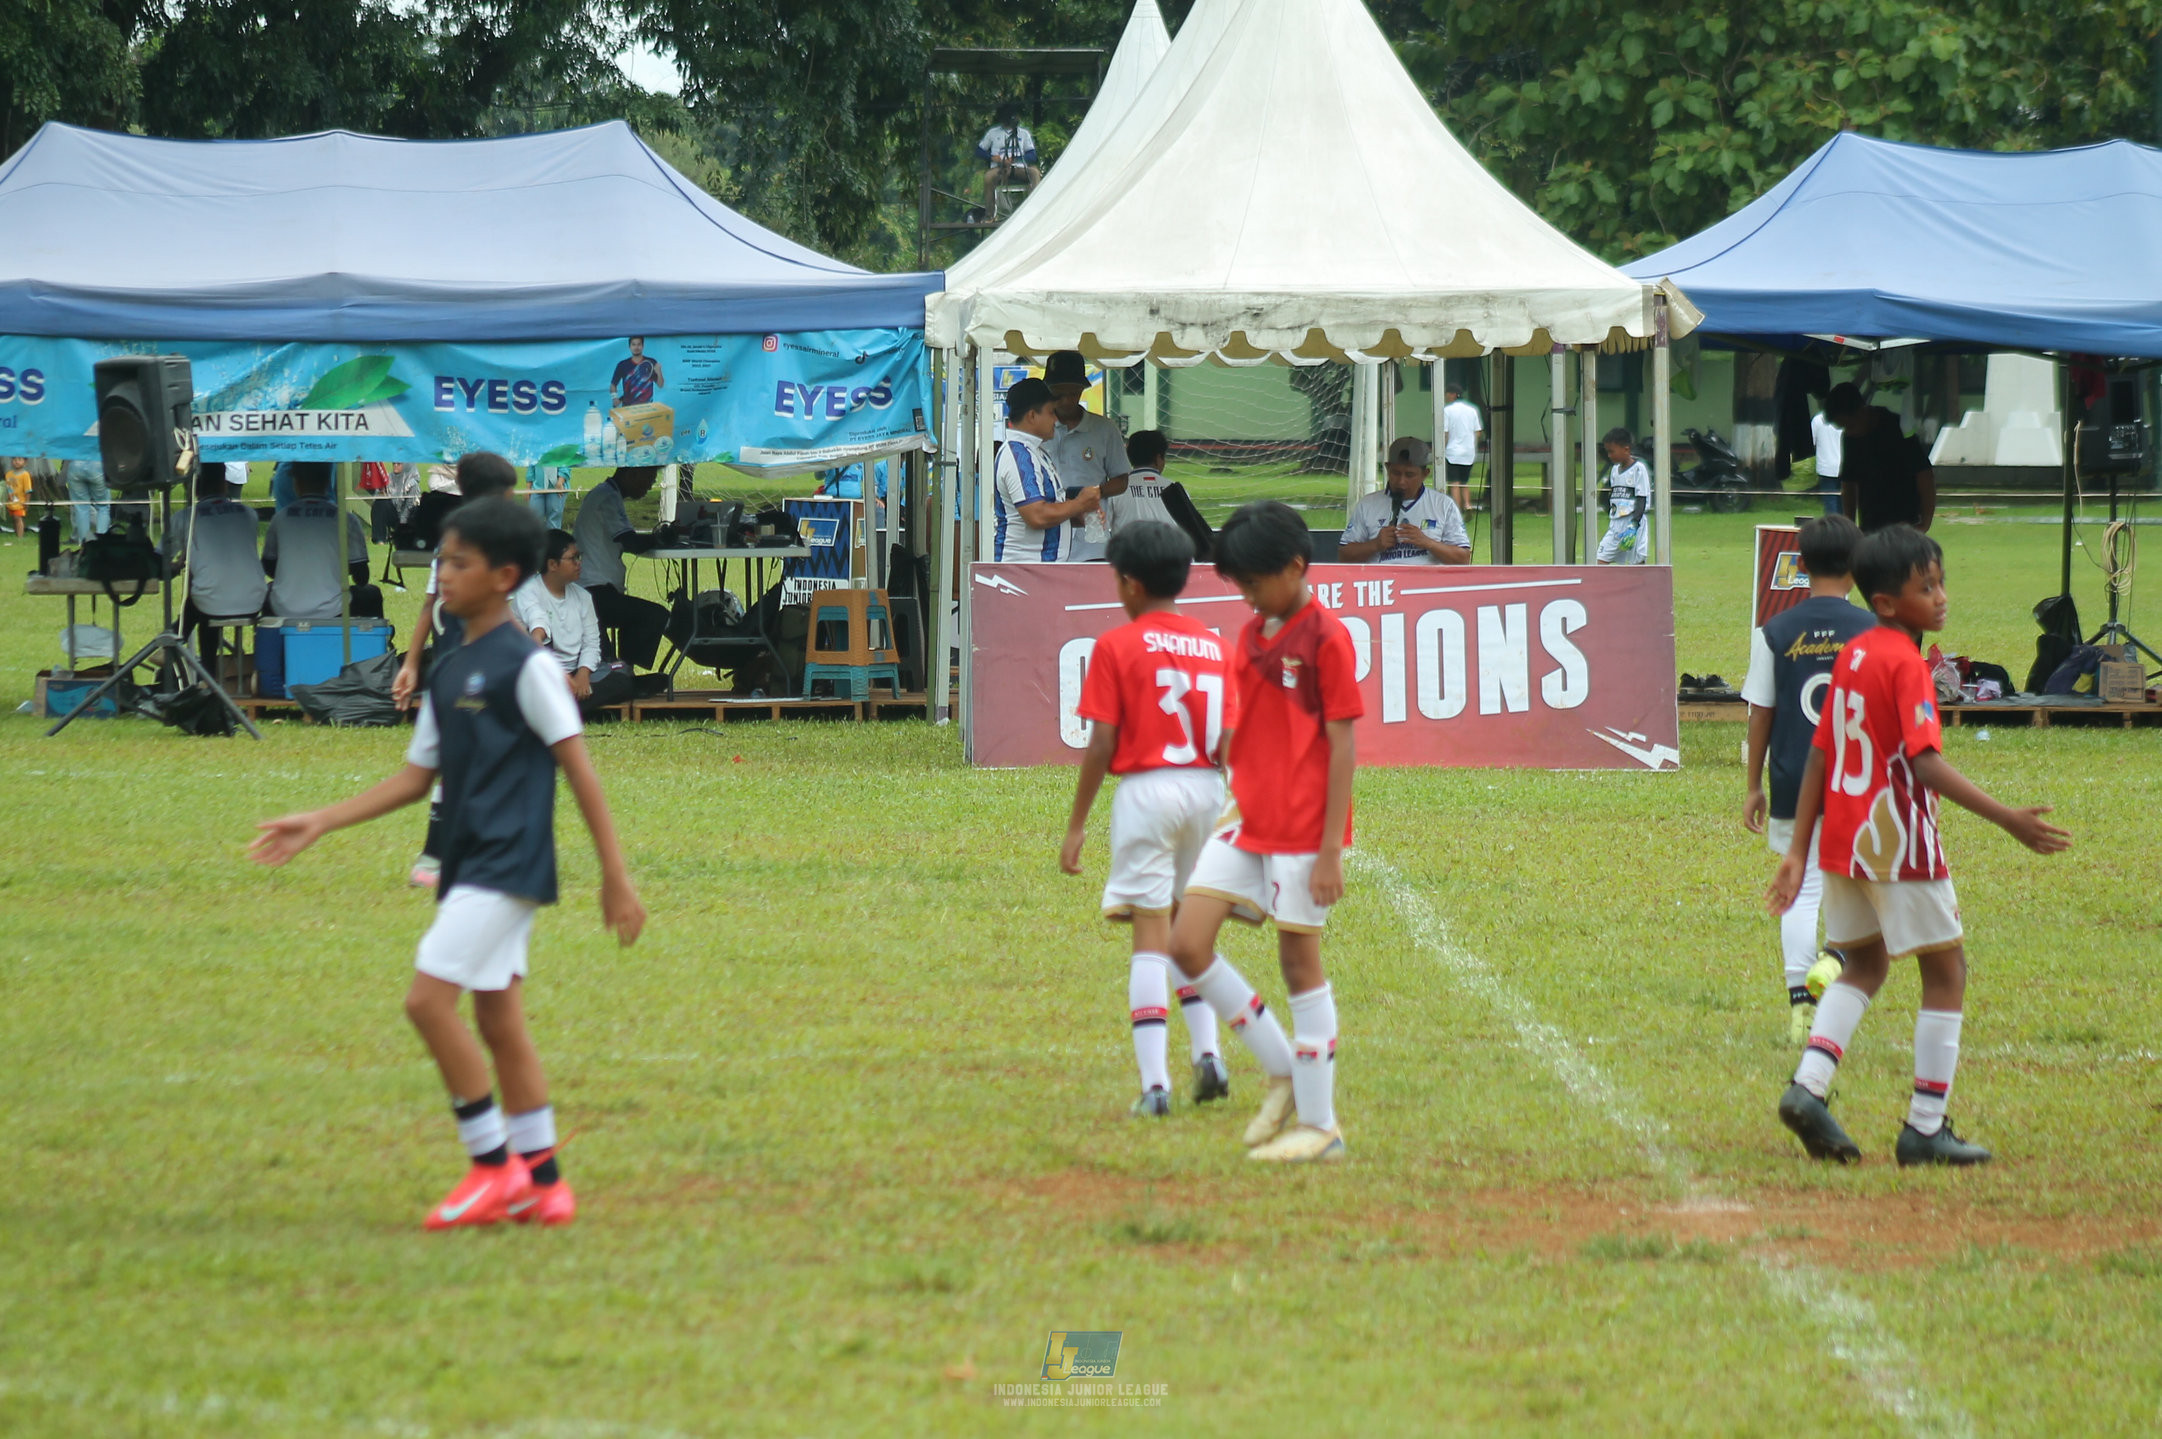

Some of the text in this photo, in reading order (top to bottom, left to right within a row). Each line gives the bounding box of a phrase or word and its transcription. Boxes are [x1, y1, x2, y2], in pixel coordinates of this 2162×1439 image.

[434, 376, 567, 415] EYESS
[774, 375, 893, 421] EYESS
[229, 413, 310, 431] SEHAT
[317, 413, 369, 431] KITA
[783, 592, 812, 604] JUNIOR
[794, 579, 837, 592] INDONESIA
[1307, 579, 1395, 609] RE THE
[1784, 632, 1845, 662] Academ
[1830, 686, 1873, 796] 13
